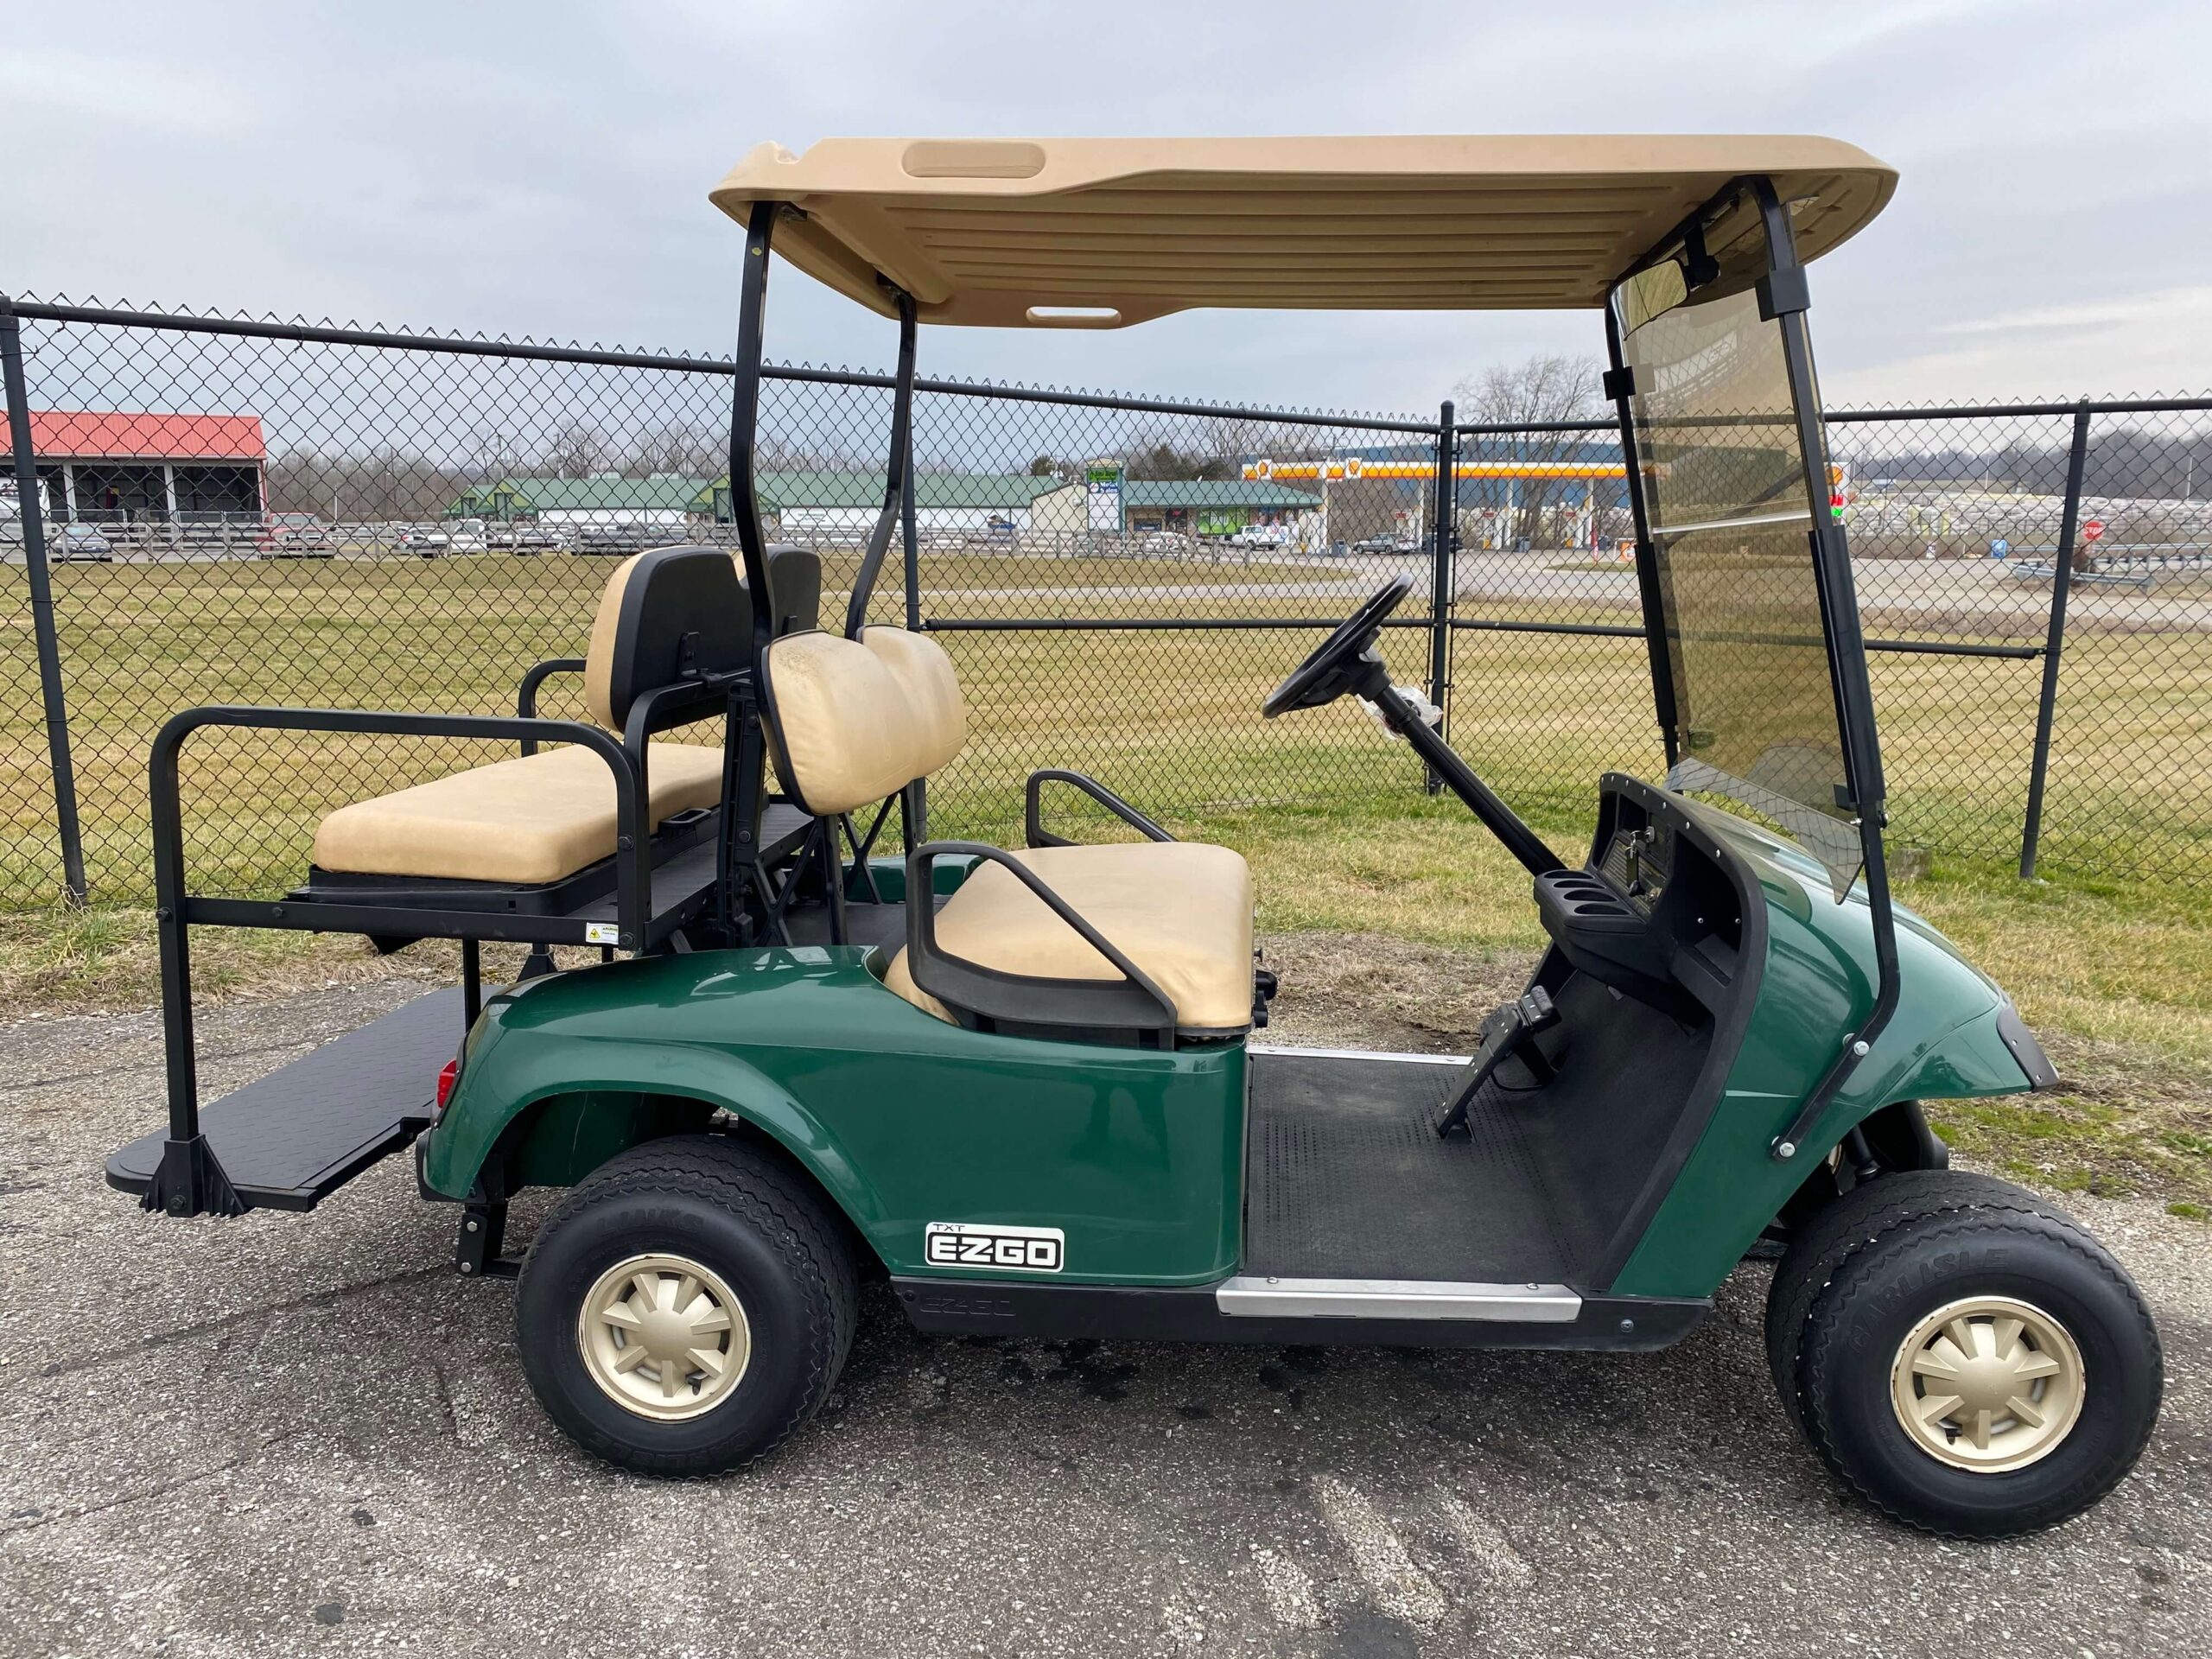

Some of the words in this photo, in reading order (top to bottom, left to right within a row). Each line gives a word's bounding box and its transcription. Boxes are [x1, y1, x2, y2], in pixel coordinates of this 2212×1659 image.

[933, 1224, 965, 1232] TXT
[931, 1236, 1056, 1267] EZGO
[1847, 1247, 2010, 1357] CARLISLE
